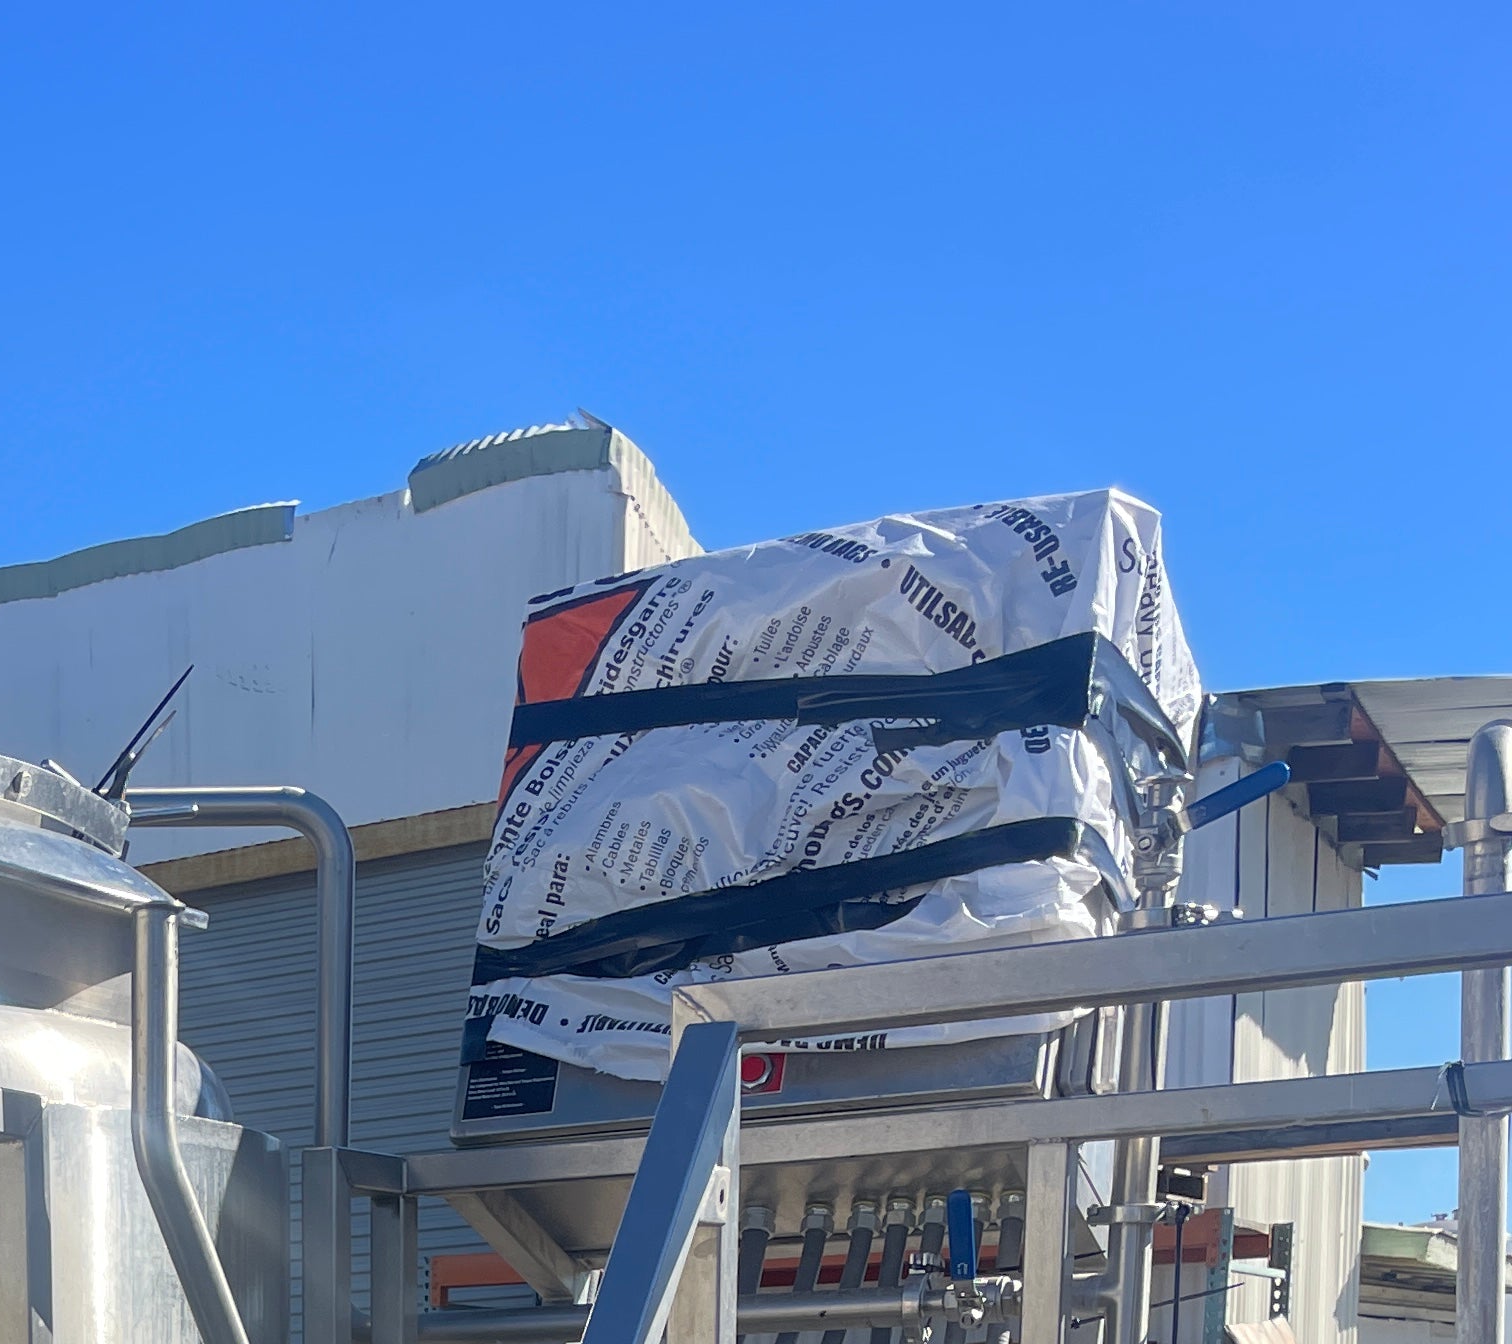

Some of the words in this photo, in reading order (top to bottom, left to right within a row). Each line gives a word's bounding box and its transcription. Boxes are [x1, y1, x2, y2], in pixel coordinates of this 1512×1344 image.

[796, 615, 832, 672] Arbustes
[585, 801, 622, 863] Alambres
[602, 822, 630, 869] Cables
[619, 820, 651, 876] Metales
[546, 853, 570, 906] para:
[659, 836, 690, 889] Bloques
